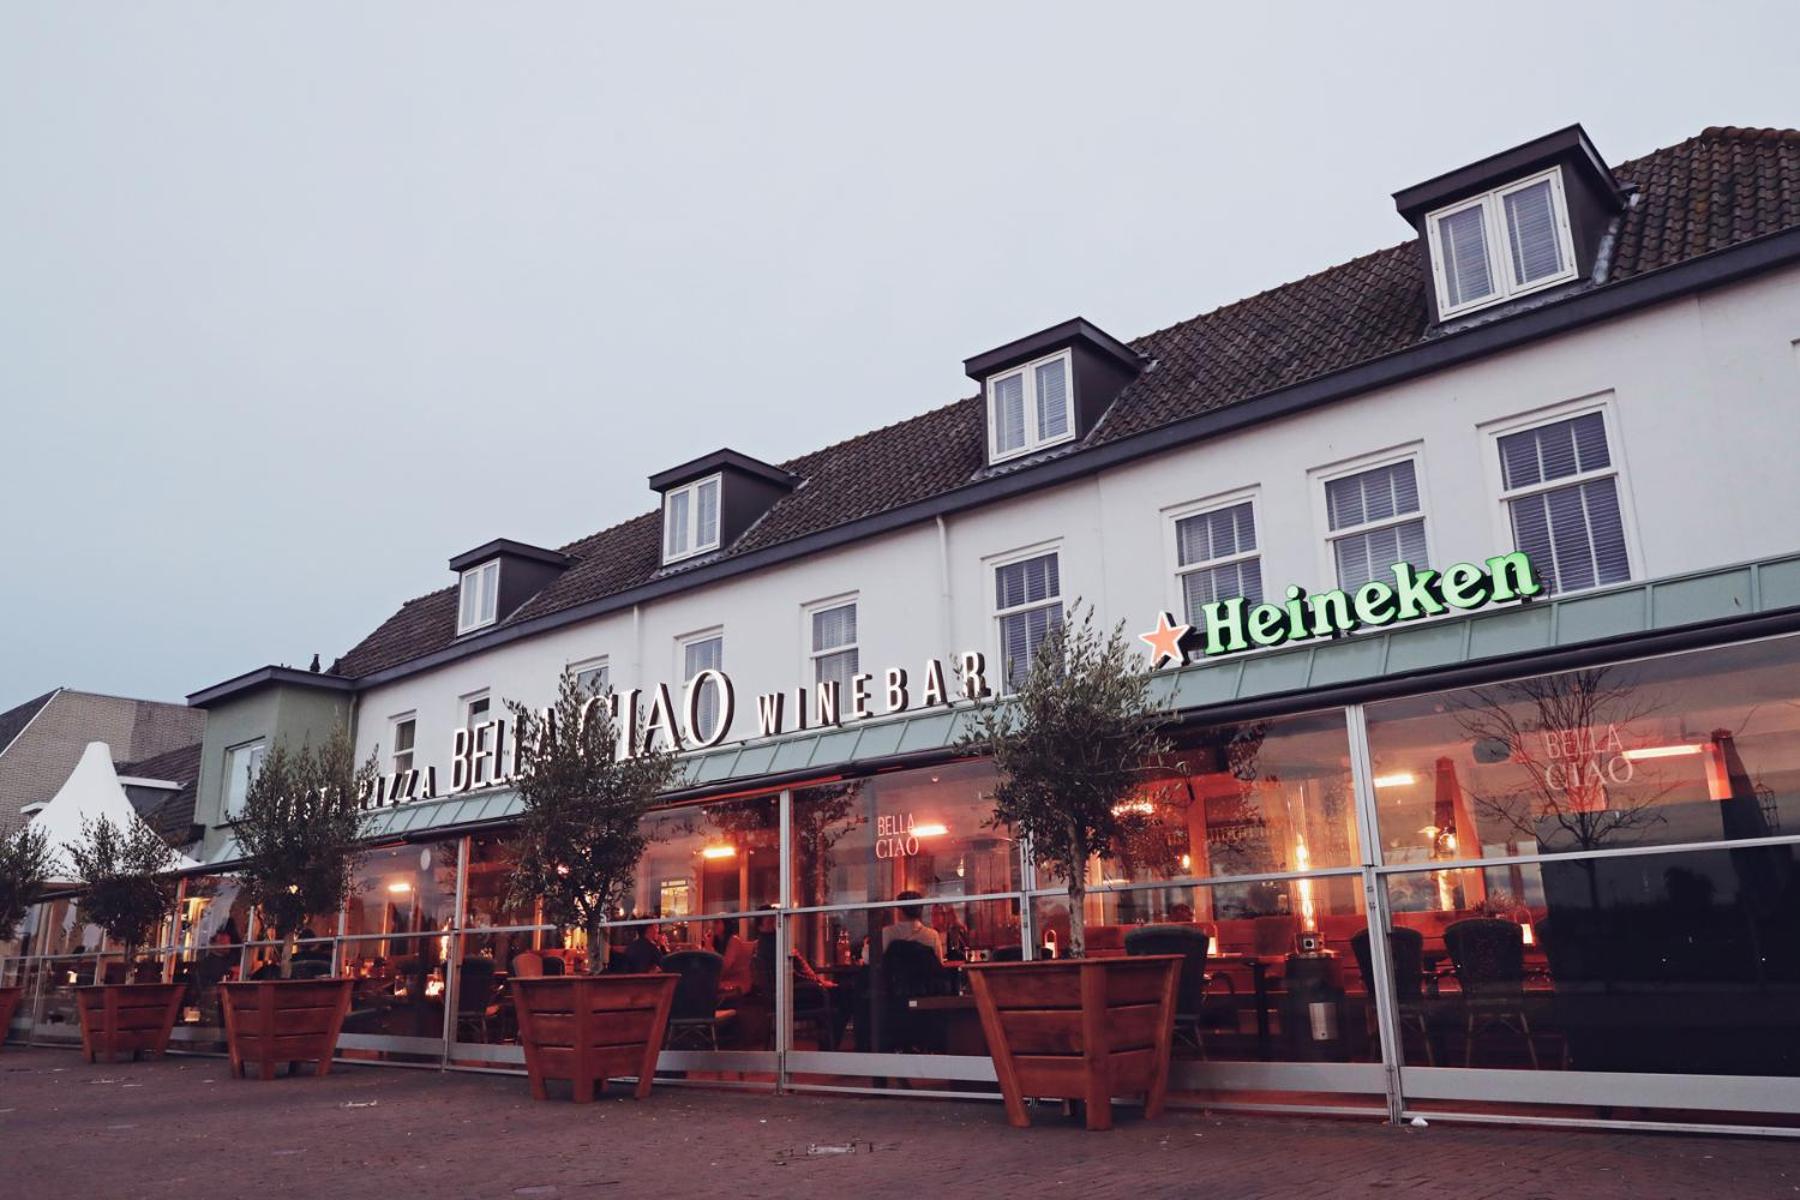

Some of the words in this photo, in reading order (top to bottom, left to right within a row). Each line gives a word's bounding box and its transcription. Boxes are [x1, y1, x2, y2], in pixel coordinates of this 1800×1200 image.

[1202, 551, 1541, 655] Heineken
[358, 766, 435, 810] PIZZA
[450, 706, 557, 793] BELLA
[576, 669, 735, 765] CIAO
[1546, 723, 1623, 759] BELLA
[1546, 756, 1633, 790] CIAO
[877, 812, 915, 837] BELLA
[875, 836, 919, 859] CIAO
